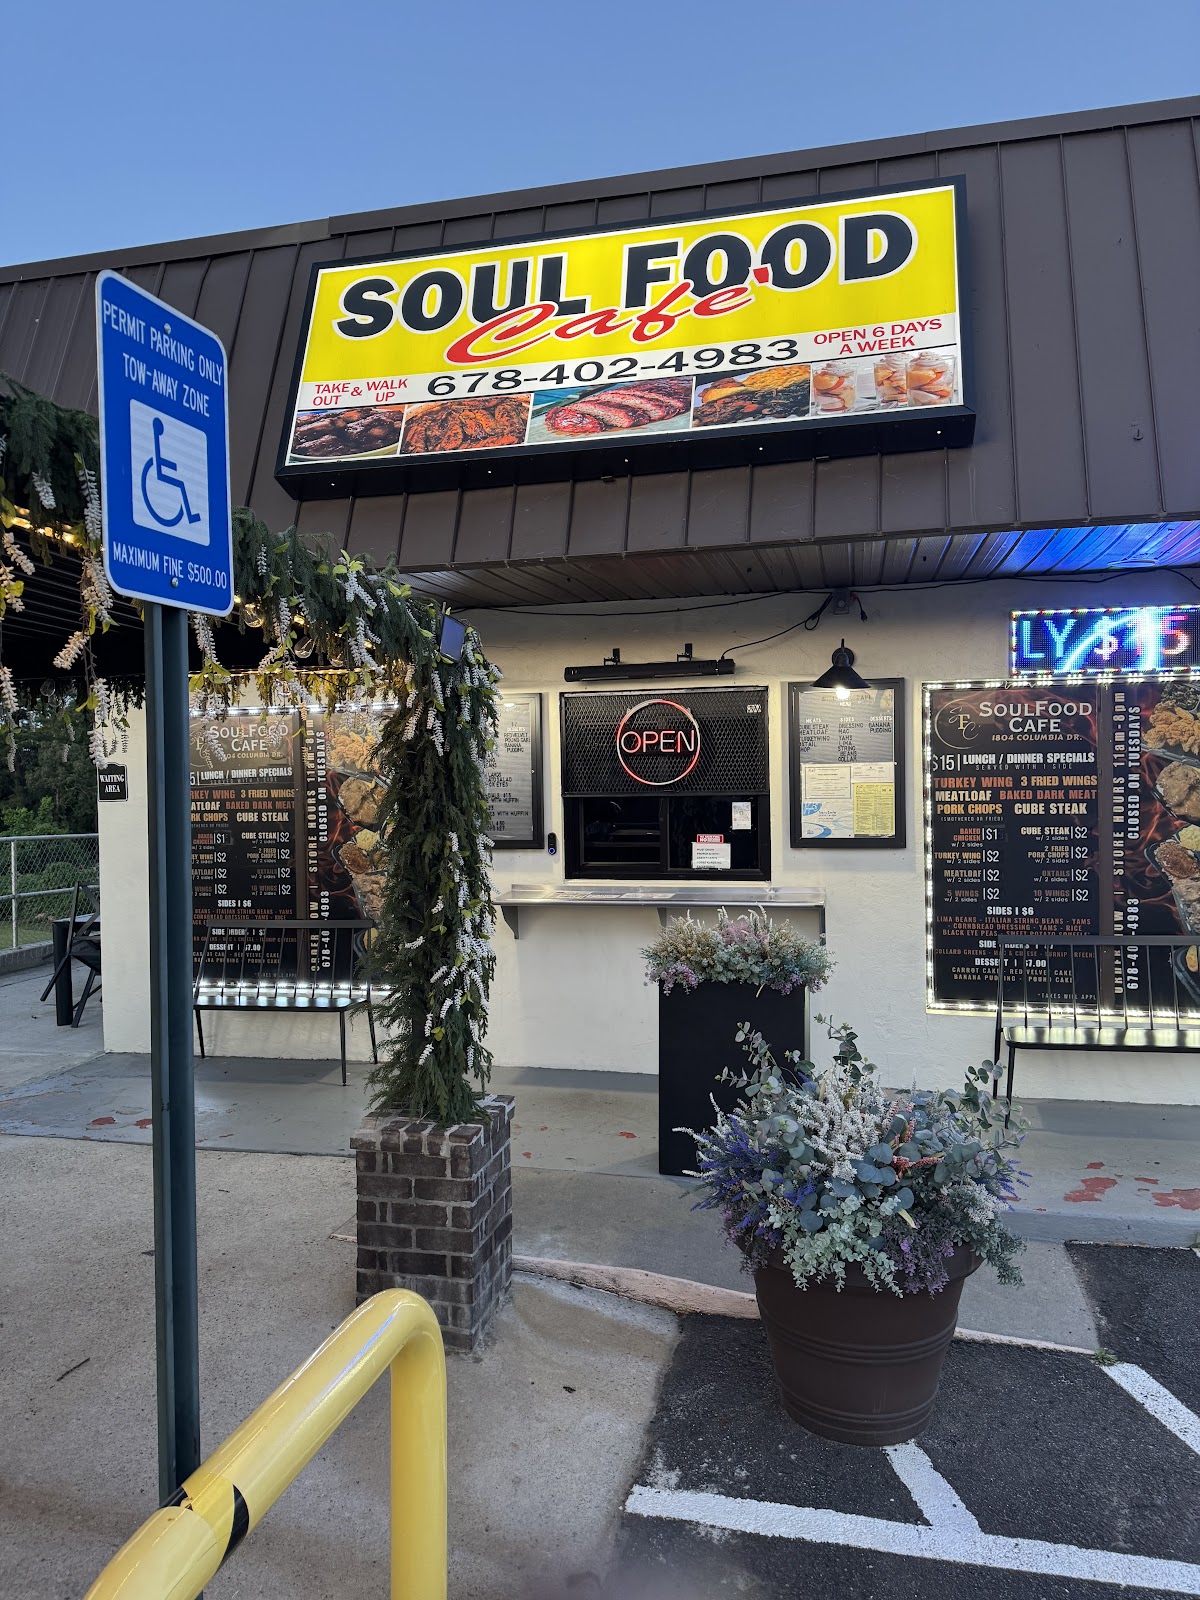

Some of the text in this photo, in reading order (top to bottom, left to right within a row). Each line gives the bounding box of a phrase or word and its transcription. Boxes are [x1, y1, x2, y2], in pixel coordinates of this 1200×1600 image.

[342, 214, 914, 338] SOUL FOOD
[814, 319, 942, 345] OPEN 6 DAYS
[104, 300, 223, 386] PERMIT PARKING ONLY
[839, 335, 915, 355] A WEEK
[428, 338, 798, 396] 678-402-4983
[123, 352, 210, 417] TOW-AWAY ZONE
[315, 379, 408, 396] TAKE & WALK
[313, 392, 395, 406] OUT UP
[113, 541, 227, 589] MAXIMUM FINE $500.00
[1009, 717, 1061, 732] CAFE
[232, 739, 267, 751] CAFE
[621, 729, 695, 754] OPEN
[933, 752, 1095, 771] $15 LUNCH DINNER SPECIALS
[100, 774, 125, 782] WAITING
[201, 770, 224, 780] LUNCH
[232, 770, 256, 778] DINNER
[259, 767, 292, 777] SPECIALS
[934, 777, 1013, 788] TURKEY WING
[1021, 776, 1097, 786] 3 FRIED WINGS
[104, 785, 120, 793] AREA
[213, 790, 235, 799] WING
[241, 789, 294, 798] 3 FRIED WINGS
[1000, 790, 1097, 800] BAKED DARK MEAT
[936, 791, 992, 801] MEATLOAF
[1113, 776, 1124, 823] HOURS
[226, 801, 249, 809] BAKED
[253, 801, 273, 809] DARK
[307, 790, 316, 828] HOURS
[937, 804, 1002, 815] PORK CHOPS
[1014, 803, 1087, 815] CUBE STEAK
[203, 812, 289, 822] CHOPS CUBE STEAK
[280, 832, 289, 842] $2
[1021, 826, 1087, 839] CUBE STEAK $2
[308, 836, 317, 872] STORE
[316, 731, 330, 967] 678-40-4983 CLOSED ON TUESDAYS
[1075, 847, 1088, 859] $2
[1114, 831, 1124, 875] STORE
[1127, 706, 1140, 990] 678-40-4983 CLOSED ON TUESDAYS
[217, 849, 290, 862] $2 $2
[987, 850, 999, 862] $2
[218, 868, 290, 878] $2 $2
[987, 869, 999, 881] $2
[1076, 869, 1088, 881] $2
[218, 884, 291, 895] $2 $2
[987, 888, 999, 900] $2
[1076, 889, 1088, 901] $2
[987, 907, 1034, 916] SIDES $6
[979, 940, 996, 948] SIDE
[975, 958, 1008, 966] DESSET
